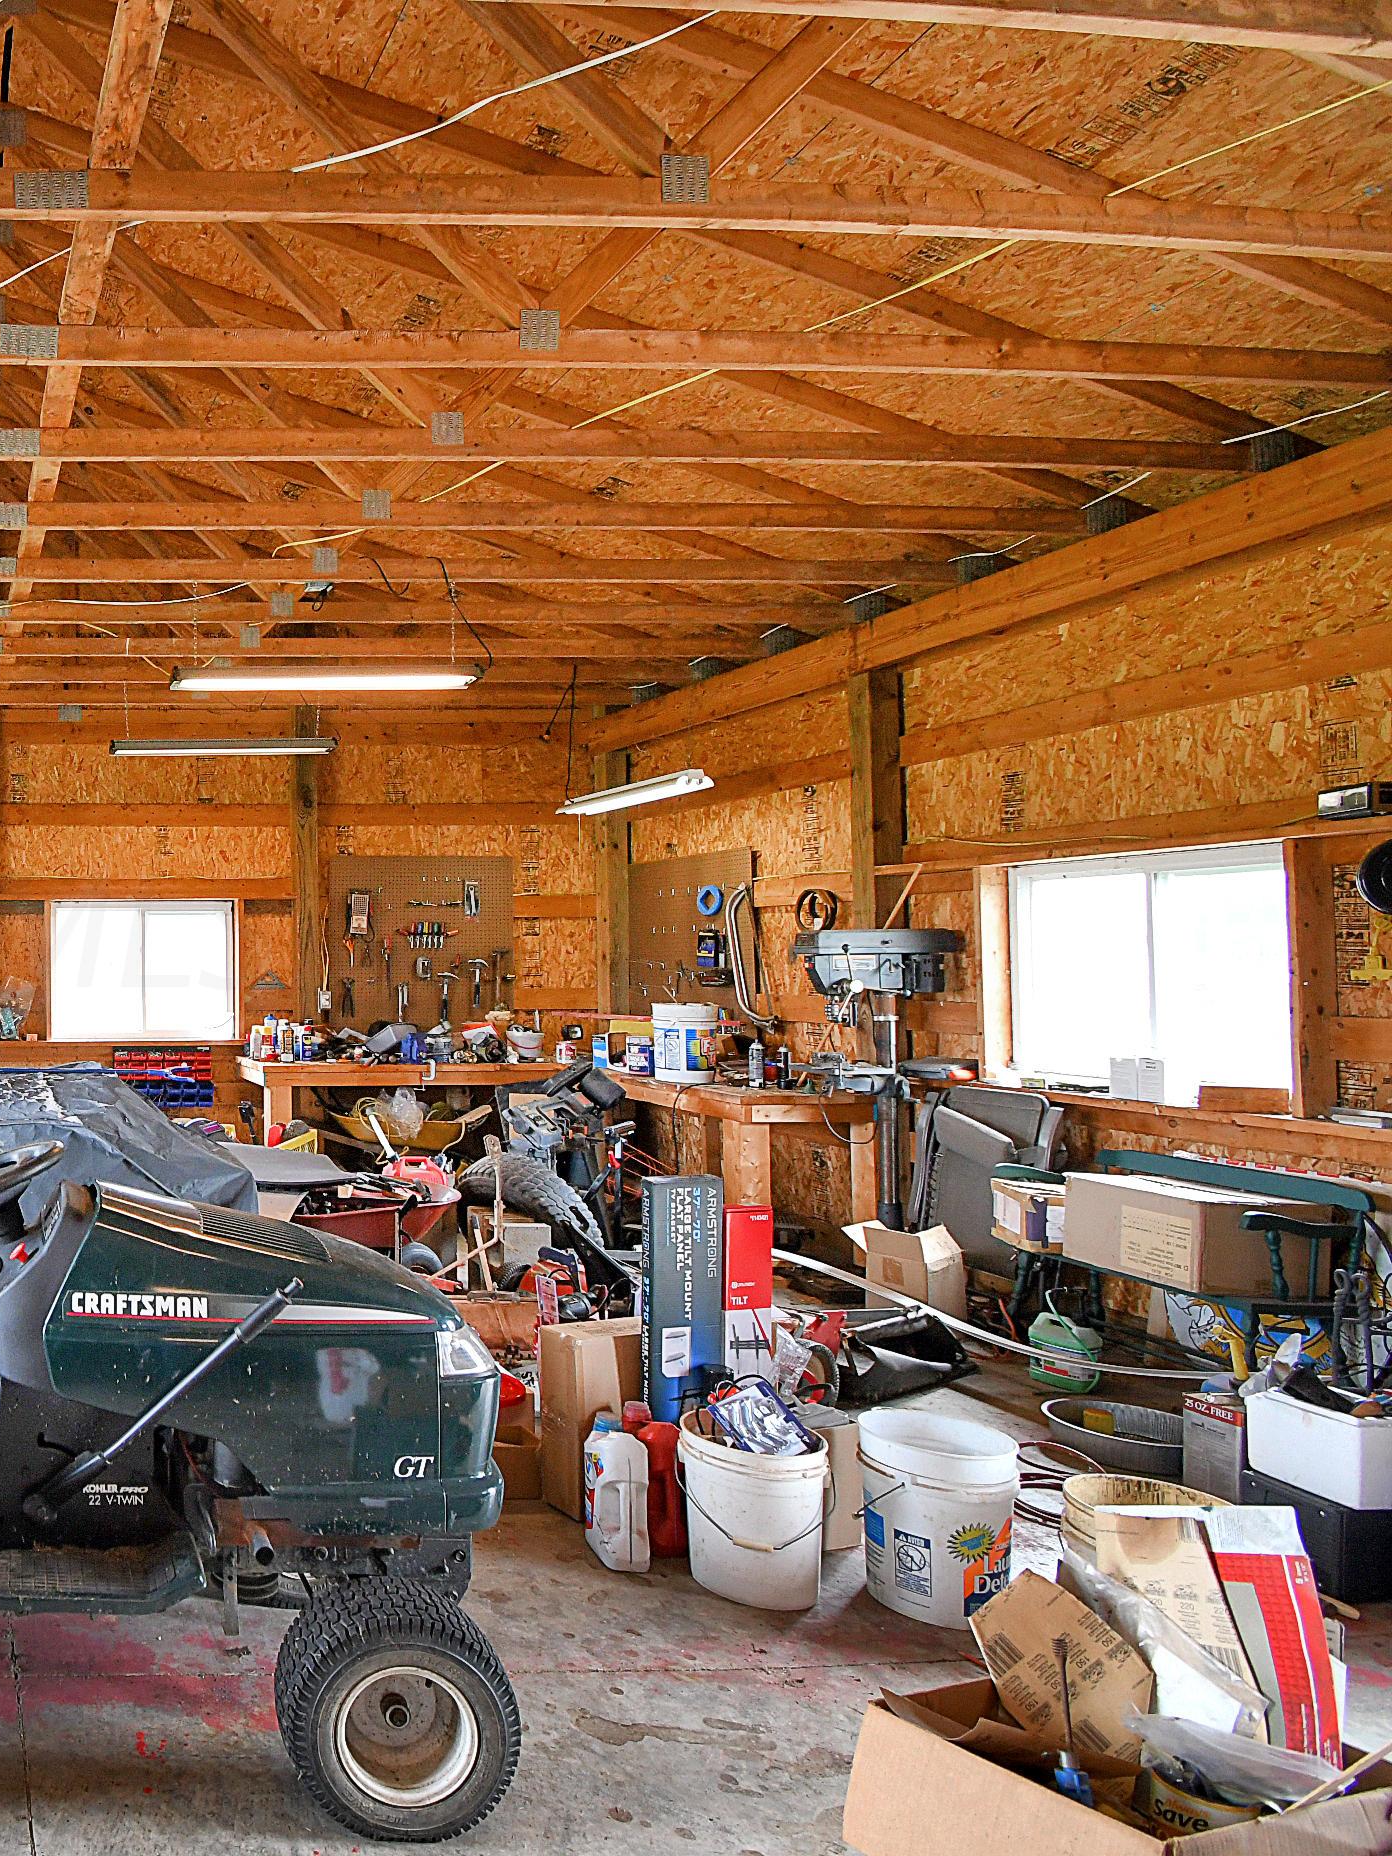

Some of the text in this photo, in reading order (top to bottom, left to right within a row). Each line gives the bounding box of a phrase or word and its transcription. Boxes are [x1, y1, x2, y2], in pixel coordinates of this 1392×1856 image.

[670, 1188, 676, 1200] TV
[642, 1187, 650, 1269] ARMSTRONG
[676, 1187, 684, 1271] FLAT PANEL
[706, 1187, 717, 1278] ARMSTRONG
[684, 1187, 692, 1320] LARGE TILT MOUNT
[71, 1291, 208, 1319] CRAFTSMAN
[730, 1295, 749, 1306] TILT
[1184, 1398, 1194, 1408] 25
[1210, 1406, 1234, 1421] FREE
[393, 1455, 435, 1478] GT
[82, 1483, 149, 1494] KOHLER PRO
[88, 1494, 144, 1506] 22 V-TWIN
[1179, 1601, 1195, 1612] 220
[1101, 1634, 1117, 1649] 150
[1075, 1656, 1091, 1669] 150
[1024, 1699, 1039, 1713] 150
[1153, 1798, 1209, 1832] Save
